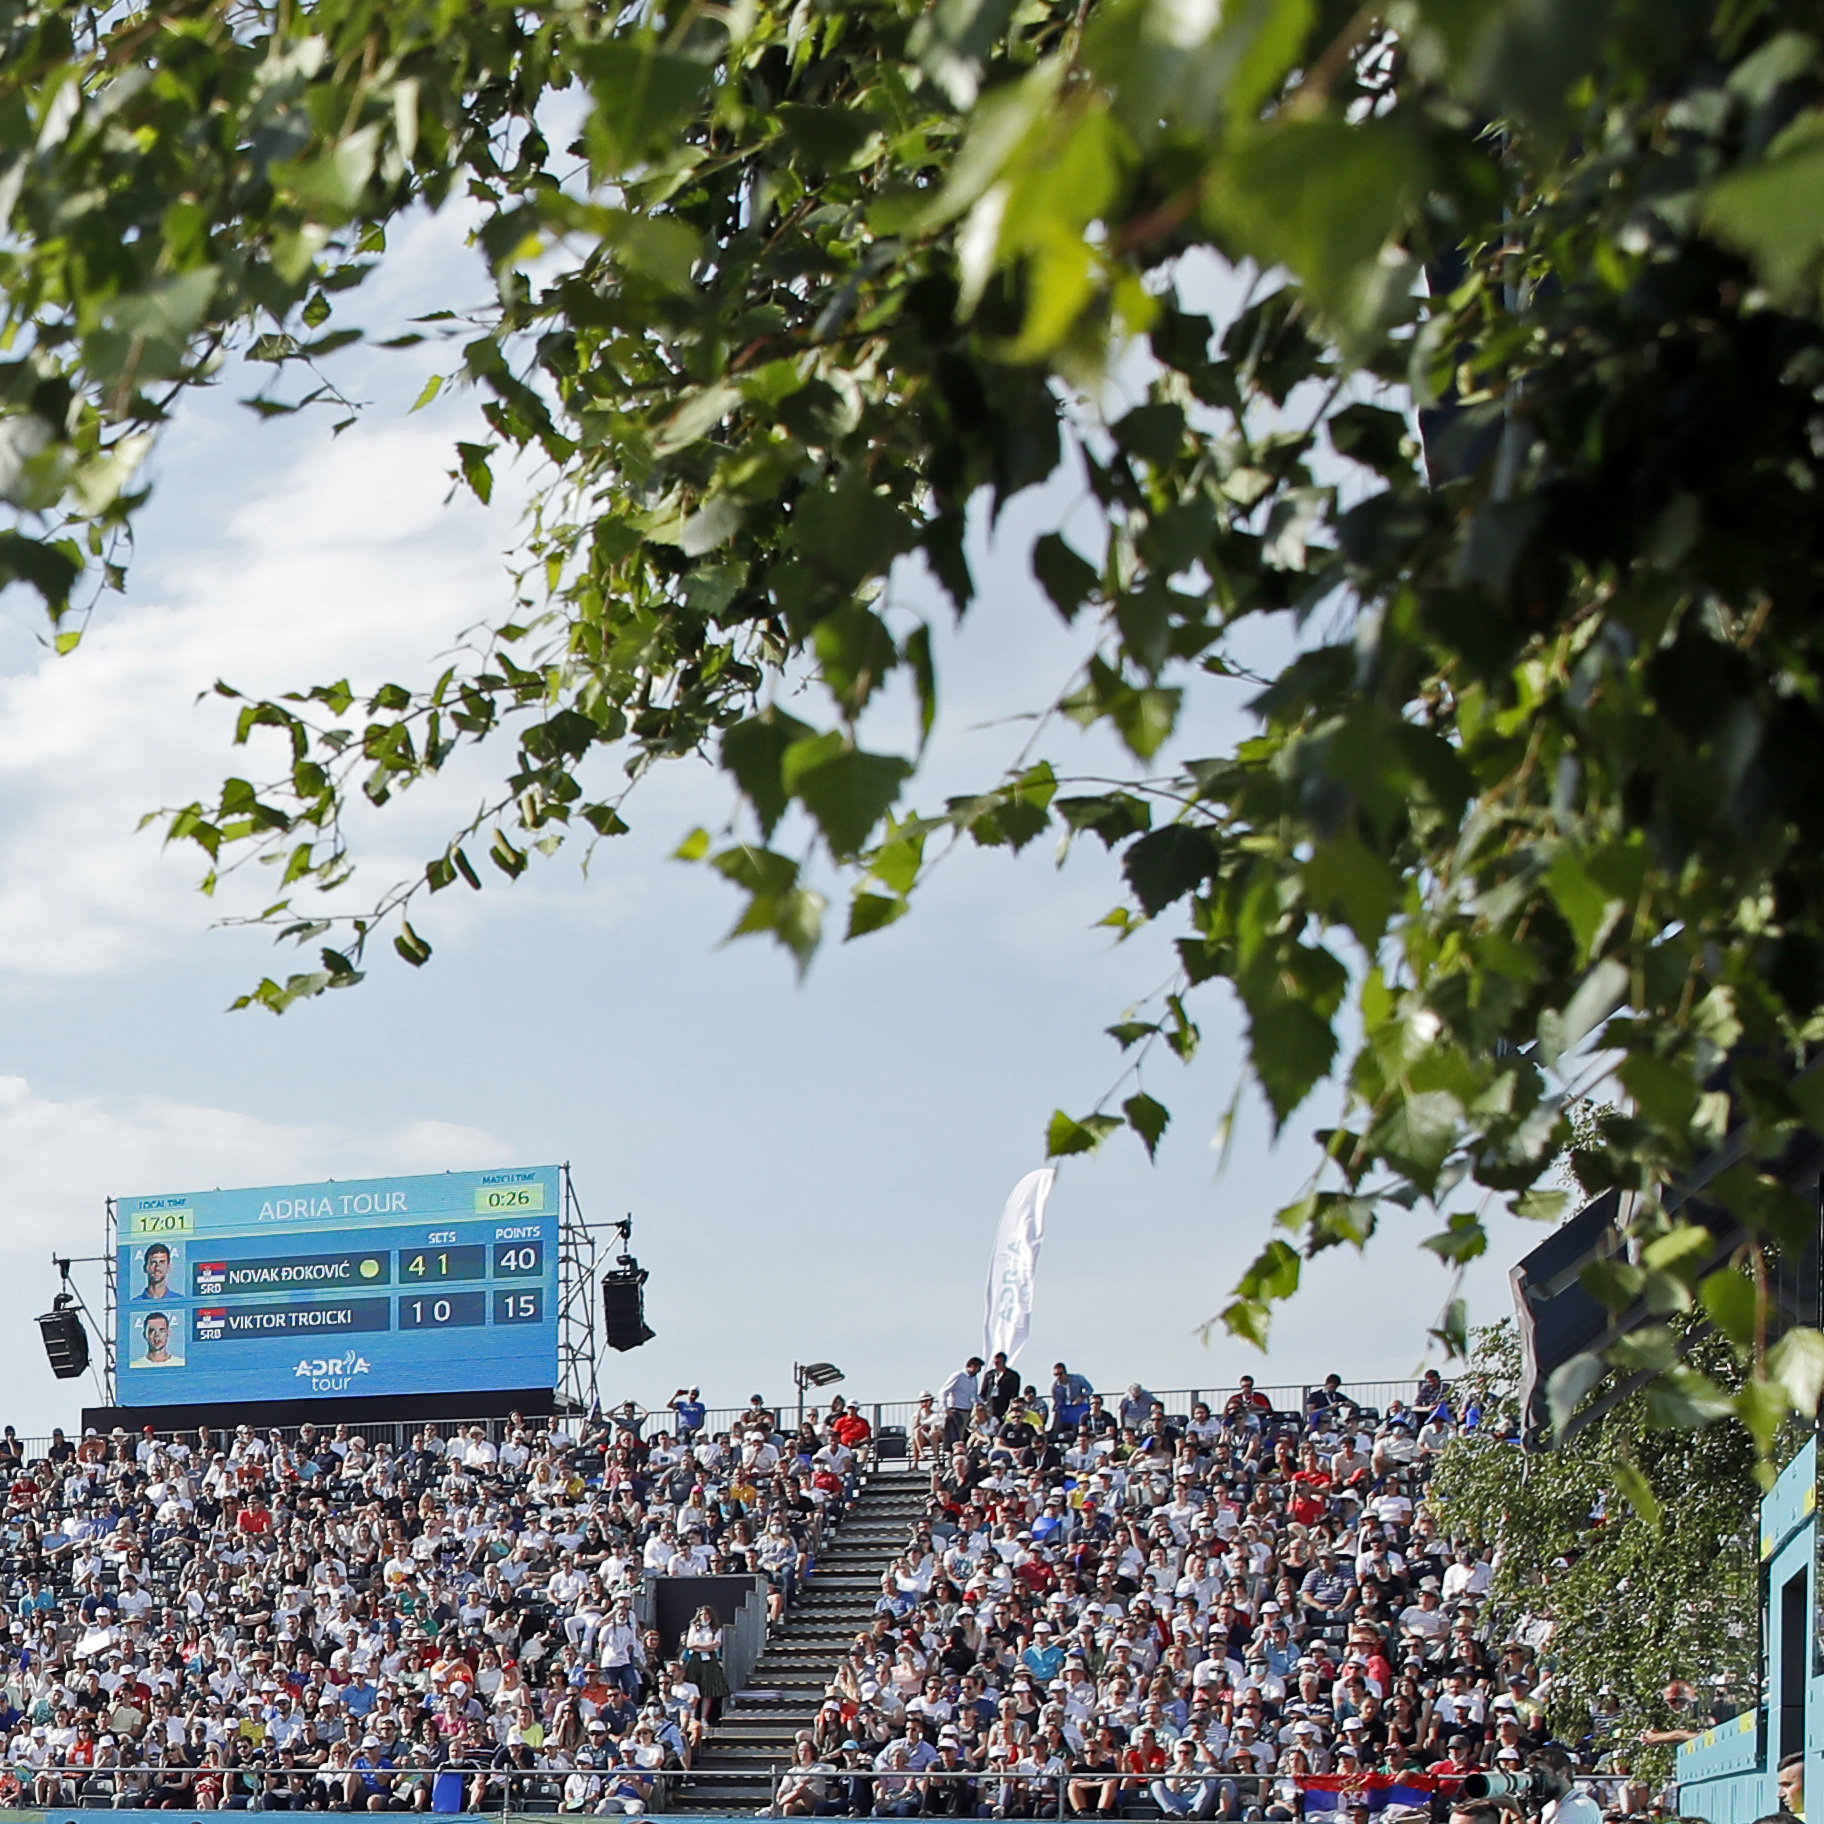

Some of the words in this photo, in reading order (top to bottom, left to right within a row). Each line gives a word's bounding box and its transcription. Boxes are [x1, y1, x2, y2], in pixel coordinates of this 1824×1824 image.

[258, 1197, 333, 1221] ADRIA
[338, 1192, 408, 1215] TOUR
[488, 1191, 530, 1207] 0:26
[140, 1215, 186, 1232] 17:01
[428, 1231, 457, 1244] SETS
[495, 1226, 541, 1239] POINTS
[229, 1267, 279, 1284] NOVAK
[281, 1260, 351, 1282] ĐOKOVIĆ
[408, 1255, 426, 1276] 4
[437, 1253, 448, 1275] 1
[500, 1248, 536, 1271] 40
[200, 1283, 222, 1295] SRB
[228, 1313, 286, 1331] VIKTOR
[288, 1309, 352, 1328] TROICKI
[412, 1301, 422, 1324] 1
[433, 1300, 451, 1322] 0
[504, 1295, 535, 1319] 15
[200, 1329, 222, 1340] SRB
[292, 1350, 372, 1377] ADRIA
[312, 1376, 351, 1391] tour
